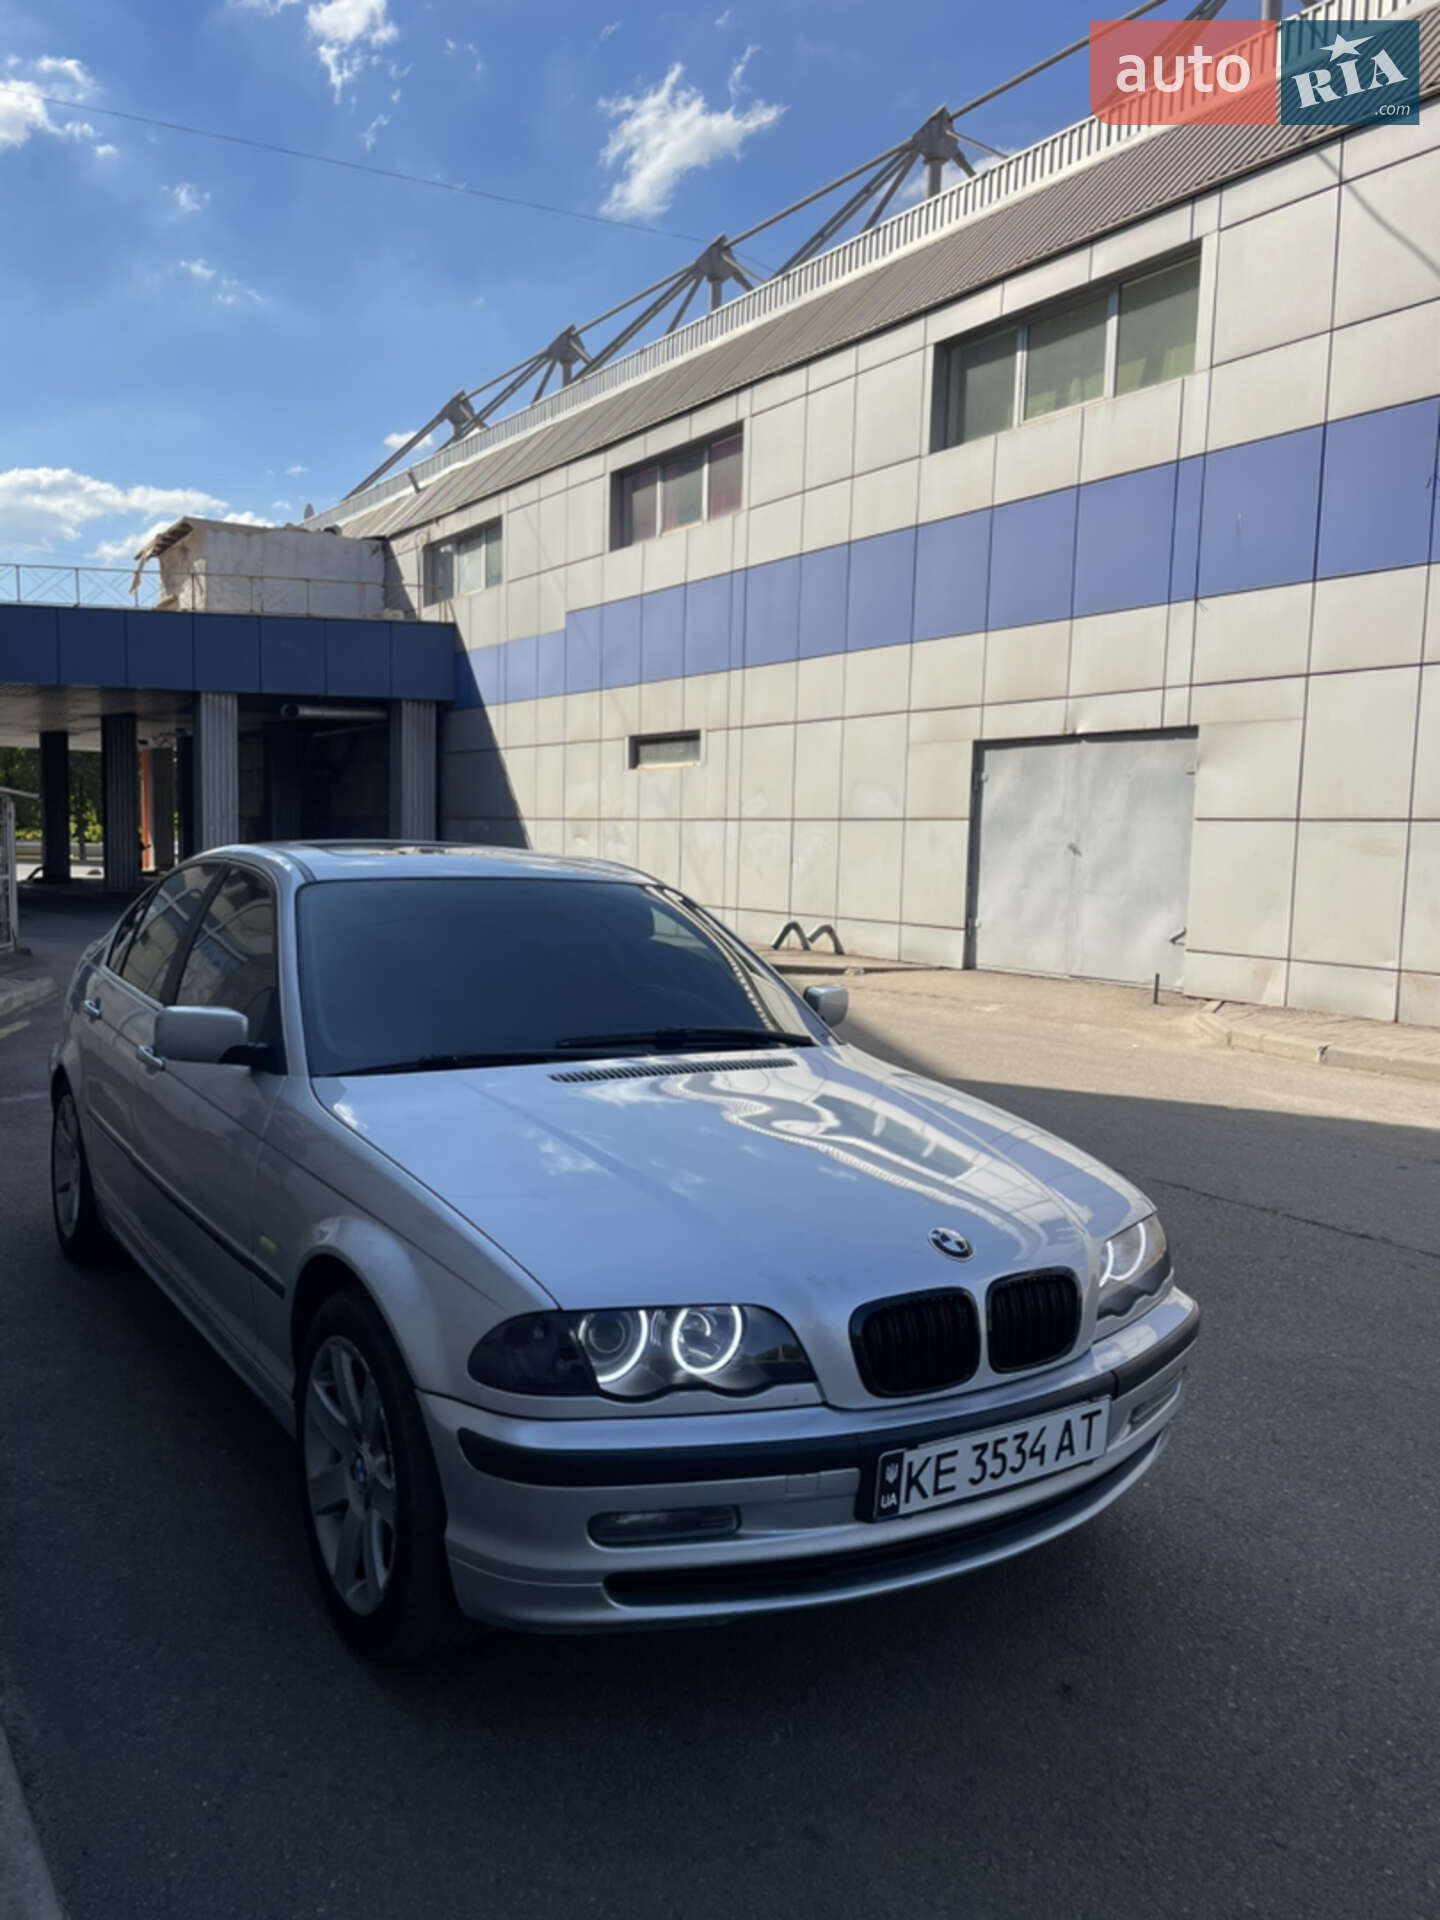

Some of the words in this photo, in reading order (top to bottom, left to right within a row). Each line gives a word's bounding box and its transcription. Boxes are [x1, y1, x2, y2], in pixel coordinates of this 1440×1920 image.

[904, 1450, 959, 1504] KE
[968, 1425, 1046, 1486] 3534
[1054, 1409, 1103, 1462] AT
[881, 1492, 898, 1510] UA
